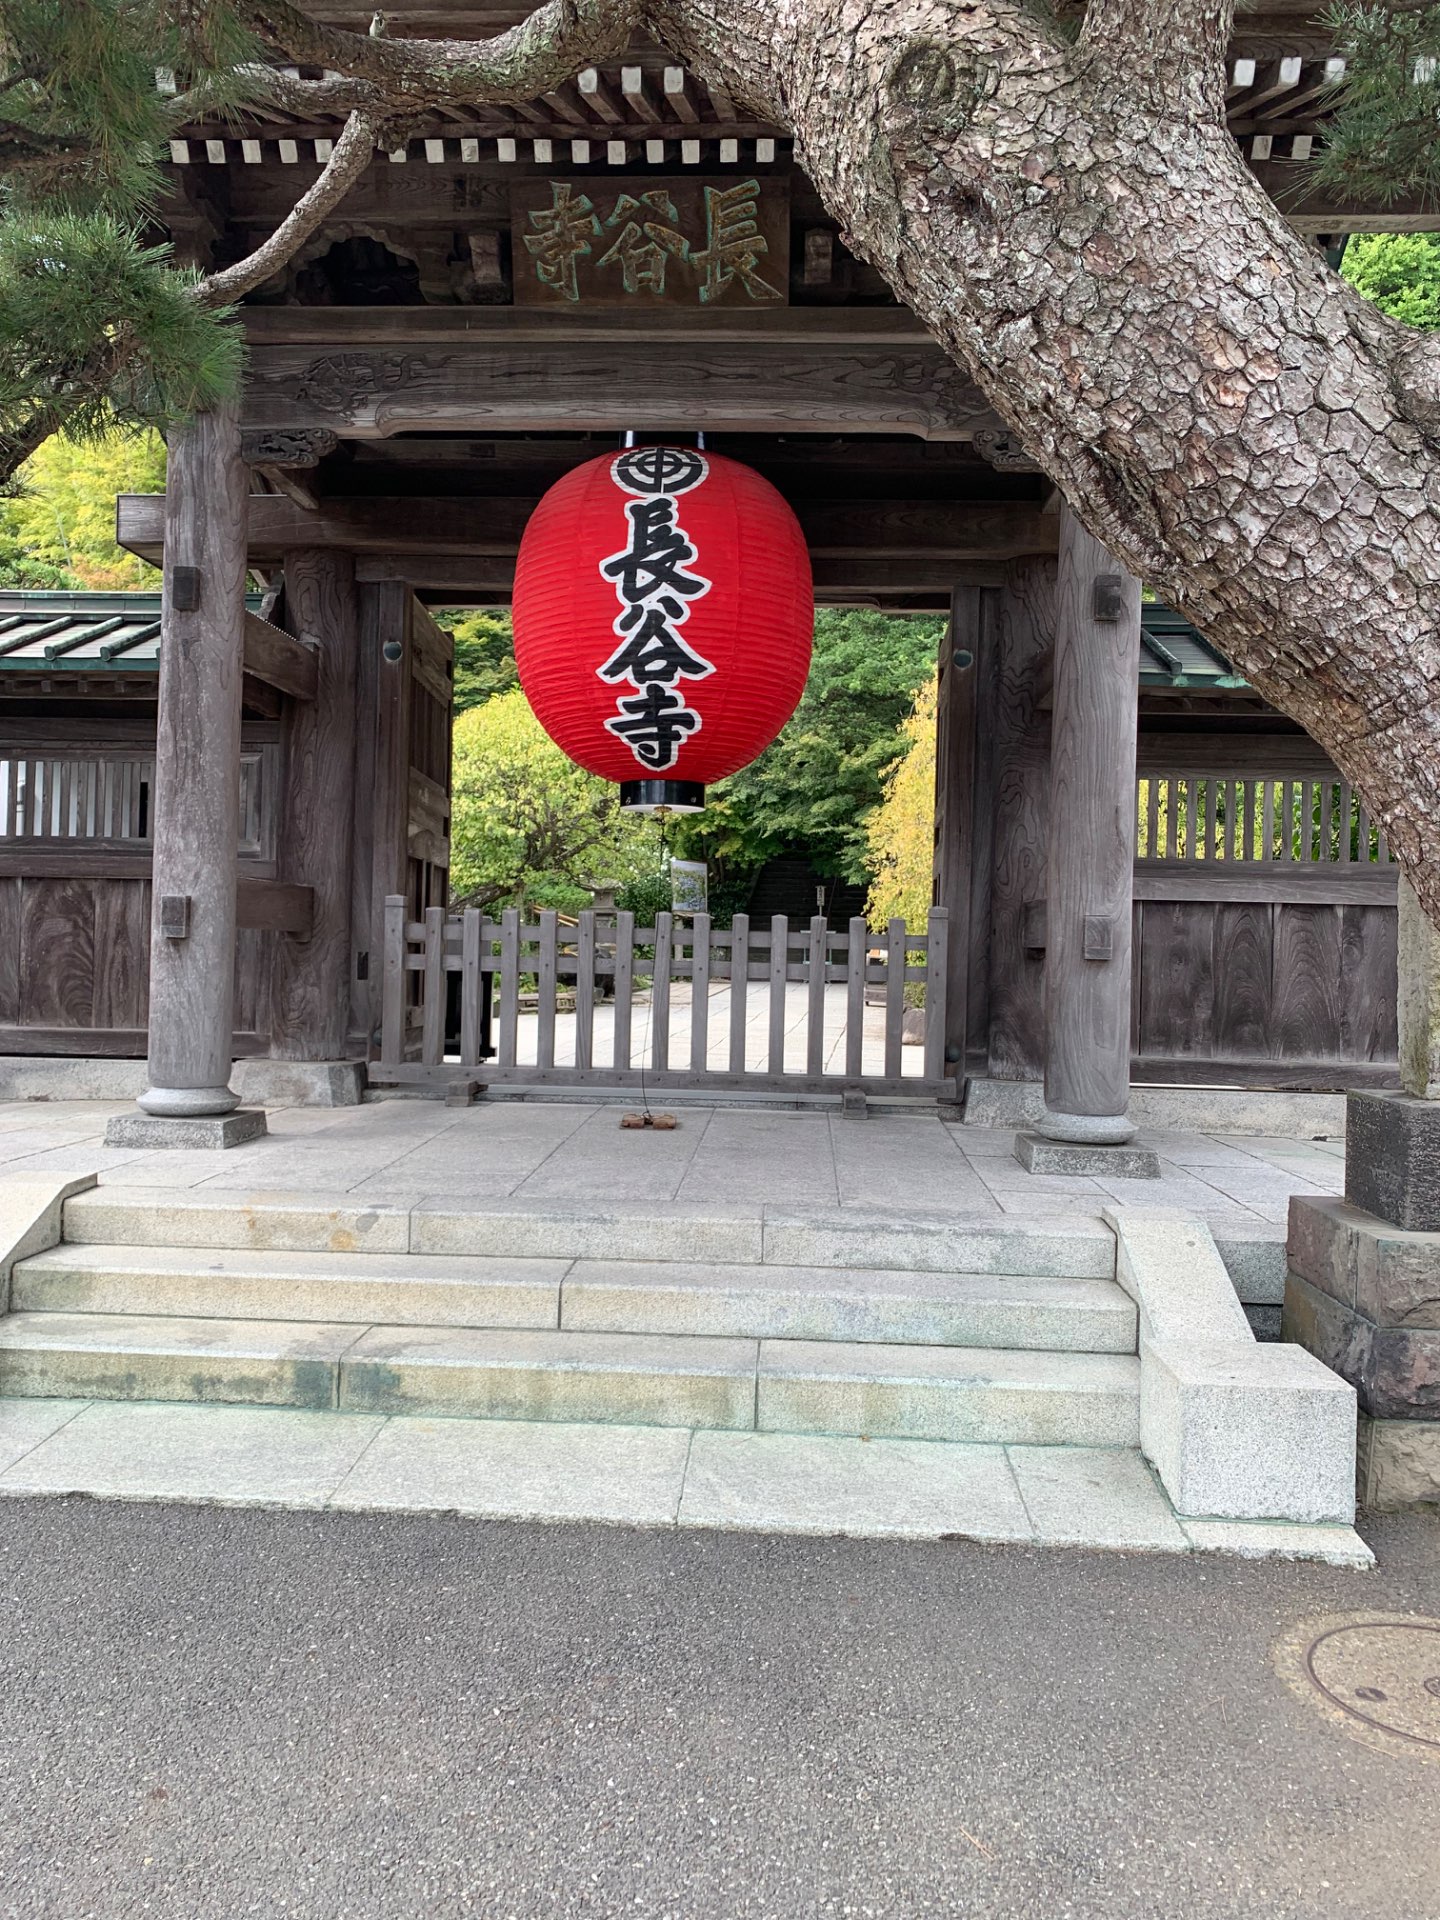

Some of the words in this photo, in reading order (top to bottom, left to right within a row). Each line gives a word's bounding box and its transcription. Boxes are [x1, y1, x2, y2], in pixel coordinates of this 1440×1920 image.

[522, 179, 784, 302] 長谷寺
[599, 496, 714, 770] 長谷寺
